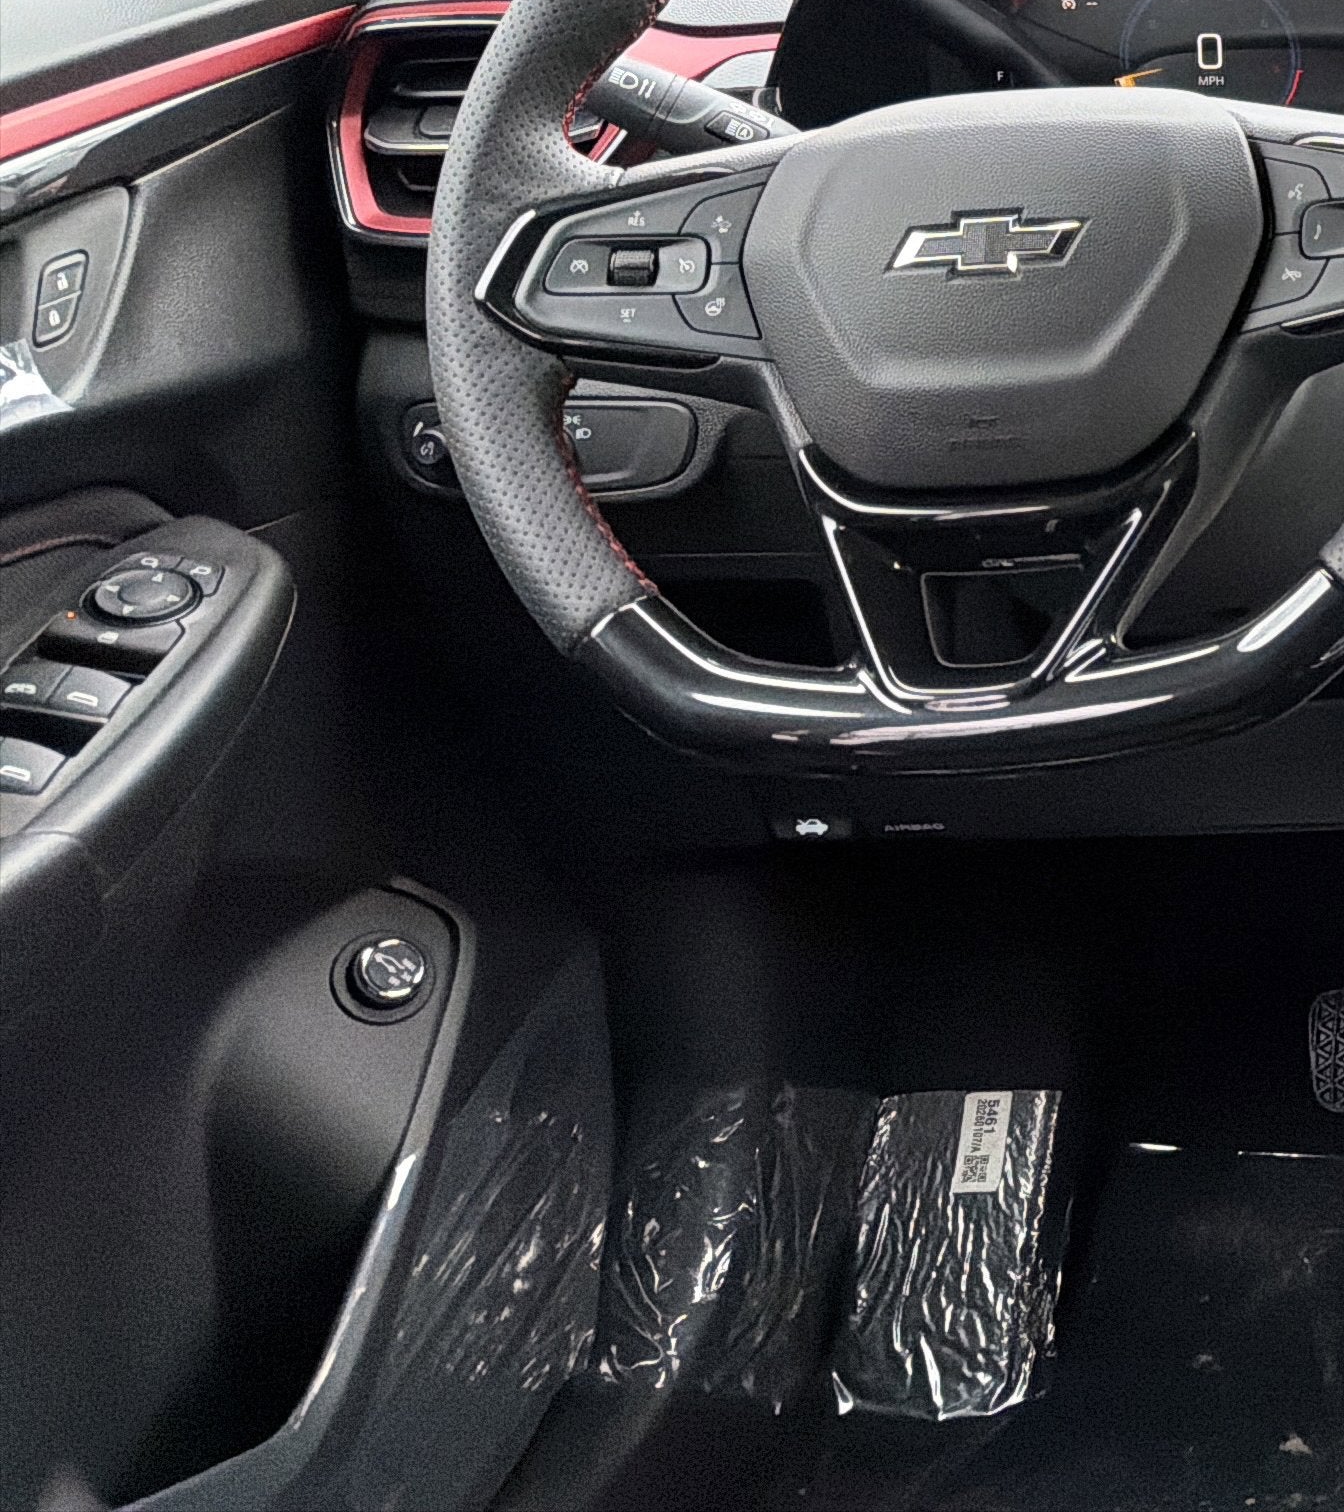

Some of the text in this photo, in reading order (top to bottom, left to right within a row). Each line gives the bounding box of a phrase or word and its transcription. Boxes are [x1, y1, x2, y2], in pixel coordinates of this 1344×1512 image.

[1197, 33, 1222, 69] 0
[997, 71, 1003, 81] F
[1198, 75, 1224, 87] MPH
[628, 217, 645, 226] RES
[620, 309, 636, 318] SET
[984, 1100, 1000, 1133] 5461
